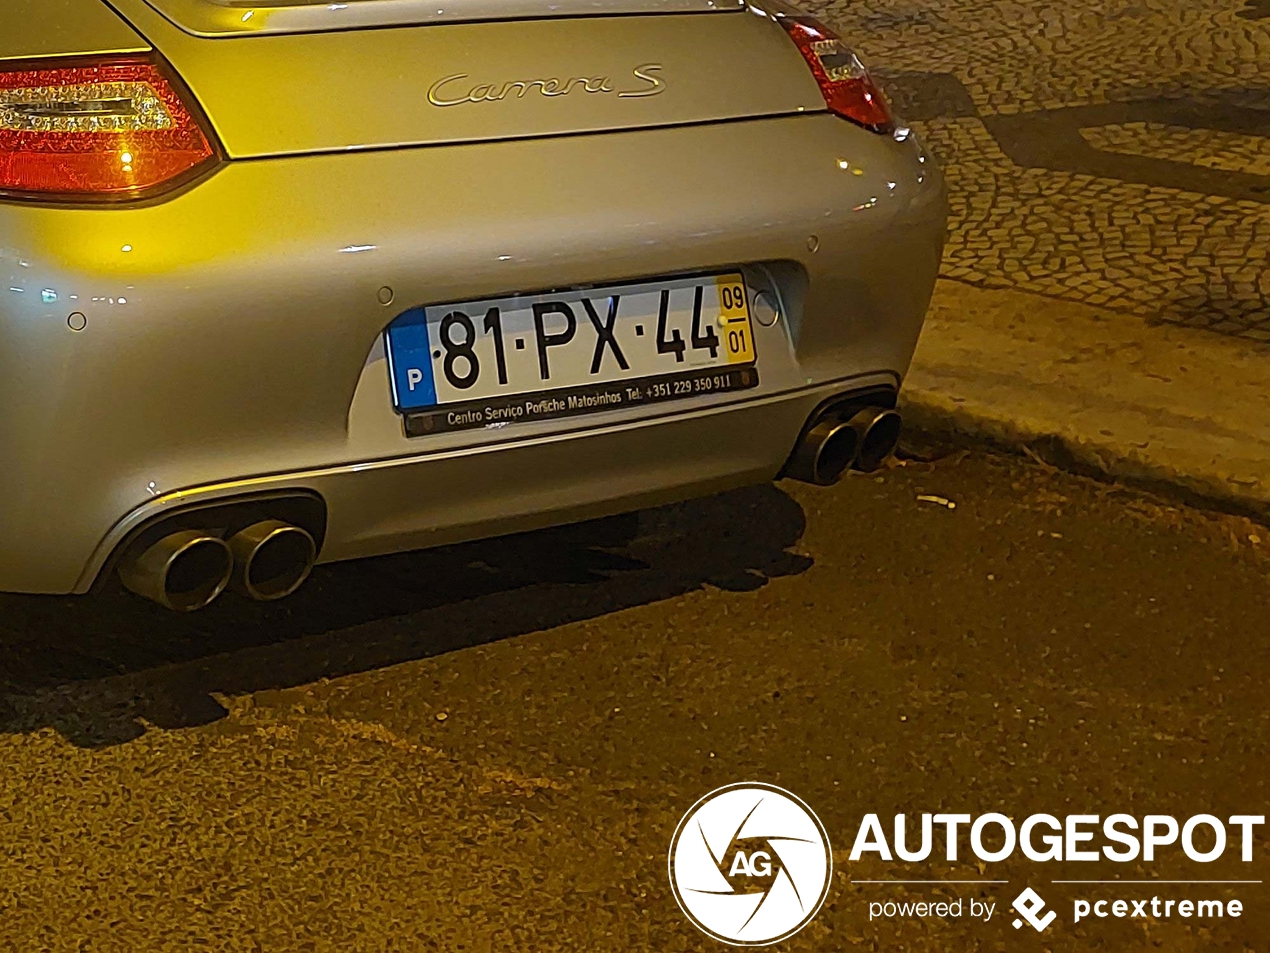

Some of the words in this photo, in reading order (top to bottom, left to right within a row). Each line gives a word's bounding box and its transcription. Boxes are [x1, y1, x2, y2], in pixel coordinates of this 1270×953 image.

[427, 73, 613, 107] Carrera
[617, 63, 667, 97] S
[721, 285, 744, 310] 09
[728, 329, 746, 354] 01
[407, 368, 423, 391] P
[447, 410, 482, 426] Centro
[484, 404, 523, 421] Serviço
[526, 398, 566, 416] Porsche
[568, 391, 622, 409] Matosinhos
[646, 382, 671, 398] +351
[673, 380, 692, 394] 229
[694, 377, 712, 391] 350
[714, 374, 731, 388] 911
